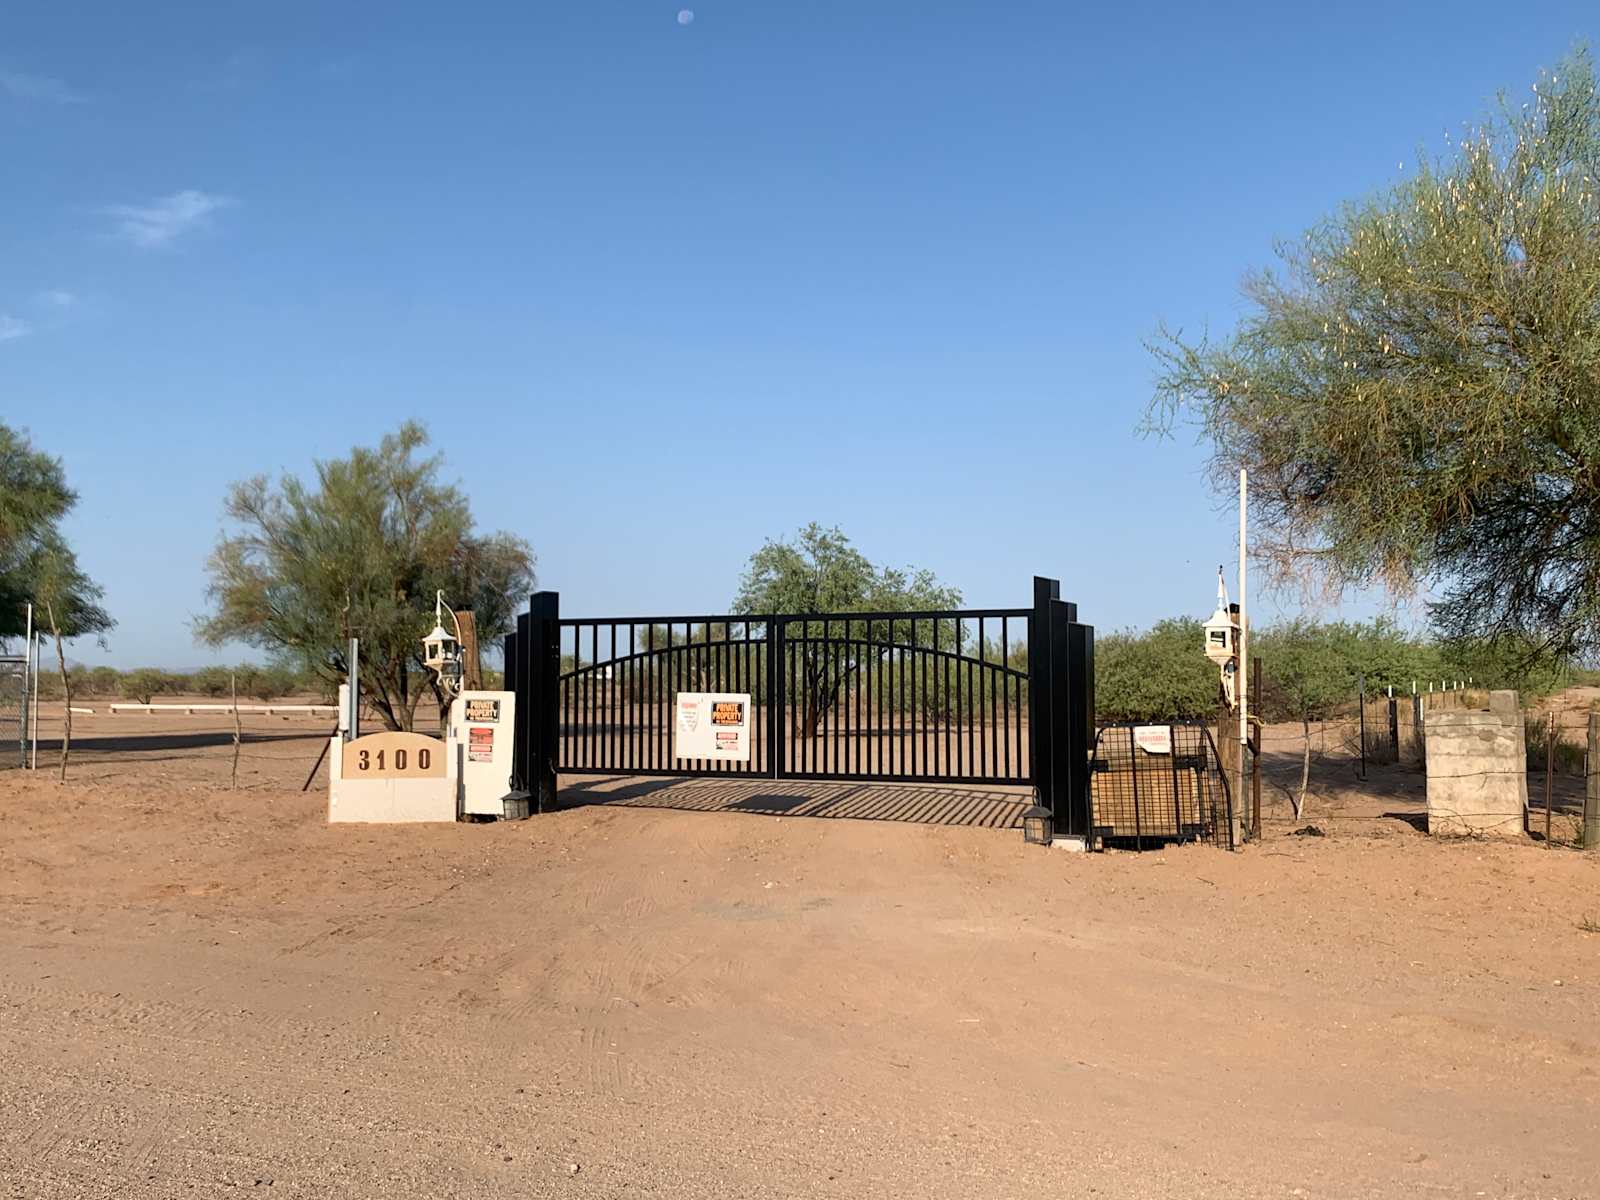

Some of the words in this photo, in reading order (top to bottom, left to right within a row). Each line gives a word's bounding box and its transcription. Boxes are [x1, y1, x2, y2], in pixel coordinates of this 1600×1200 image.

[470, 700, 494, 709] PRIVATE
[716, 703, 738, 711] PRIVATE
[466, 709, 498, 718] PROPERTY
[713, 711, 742, 720] PROPERTY
[359, 749, 430, 770] 3100
